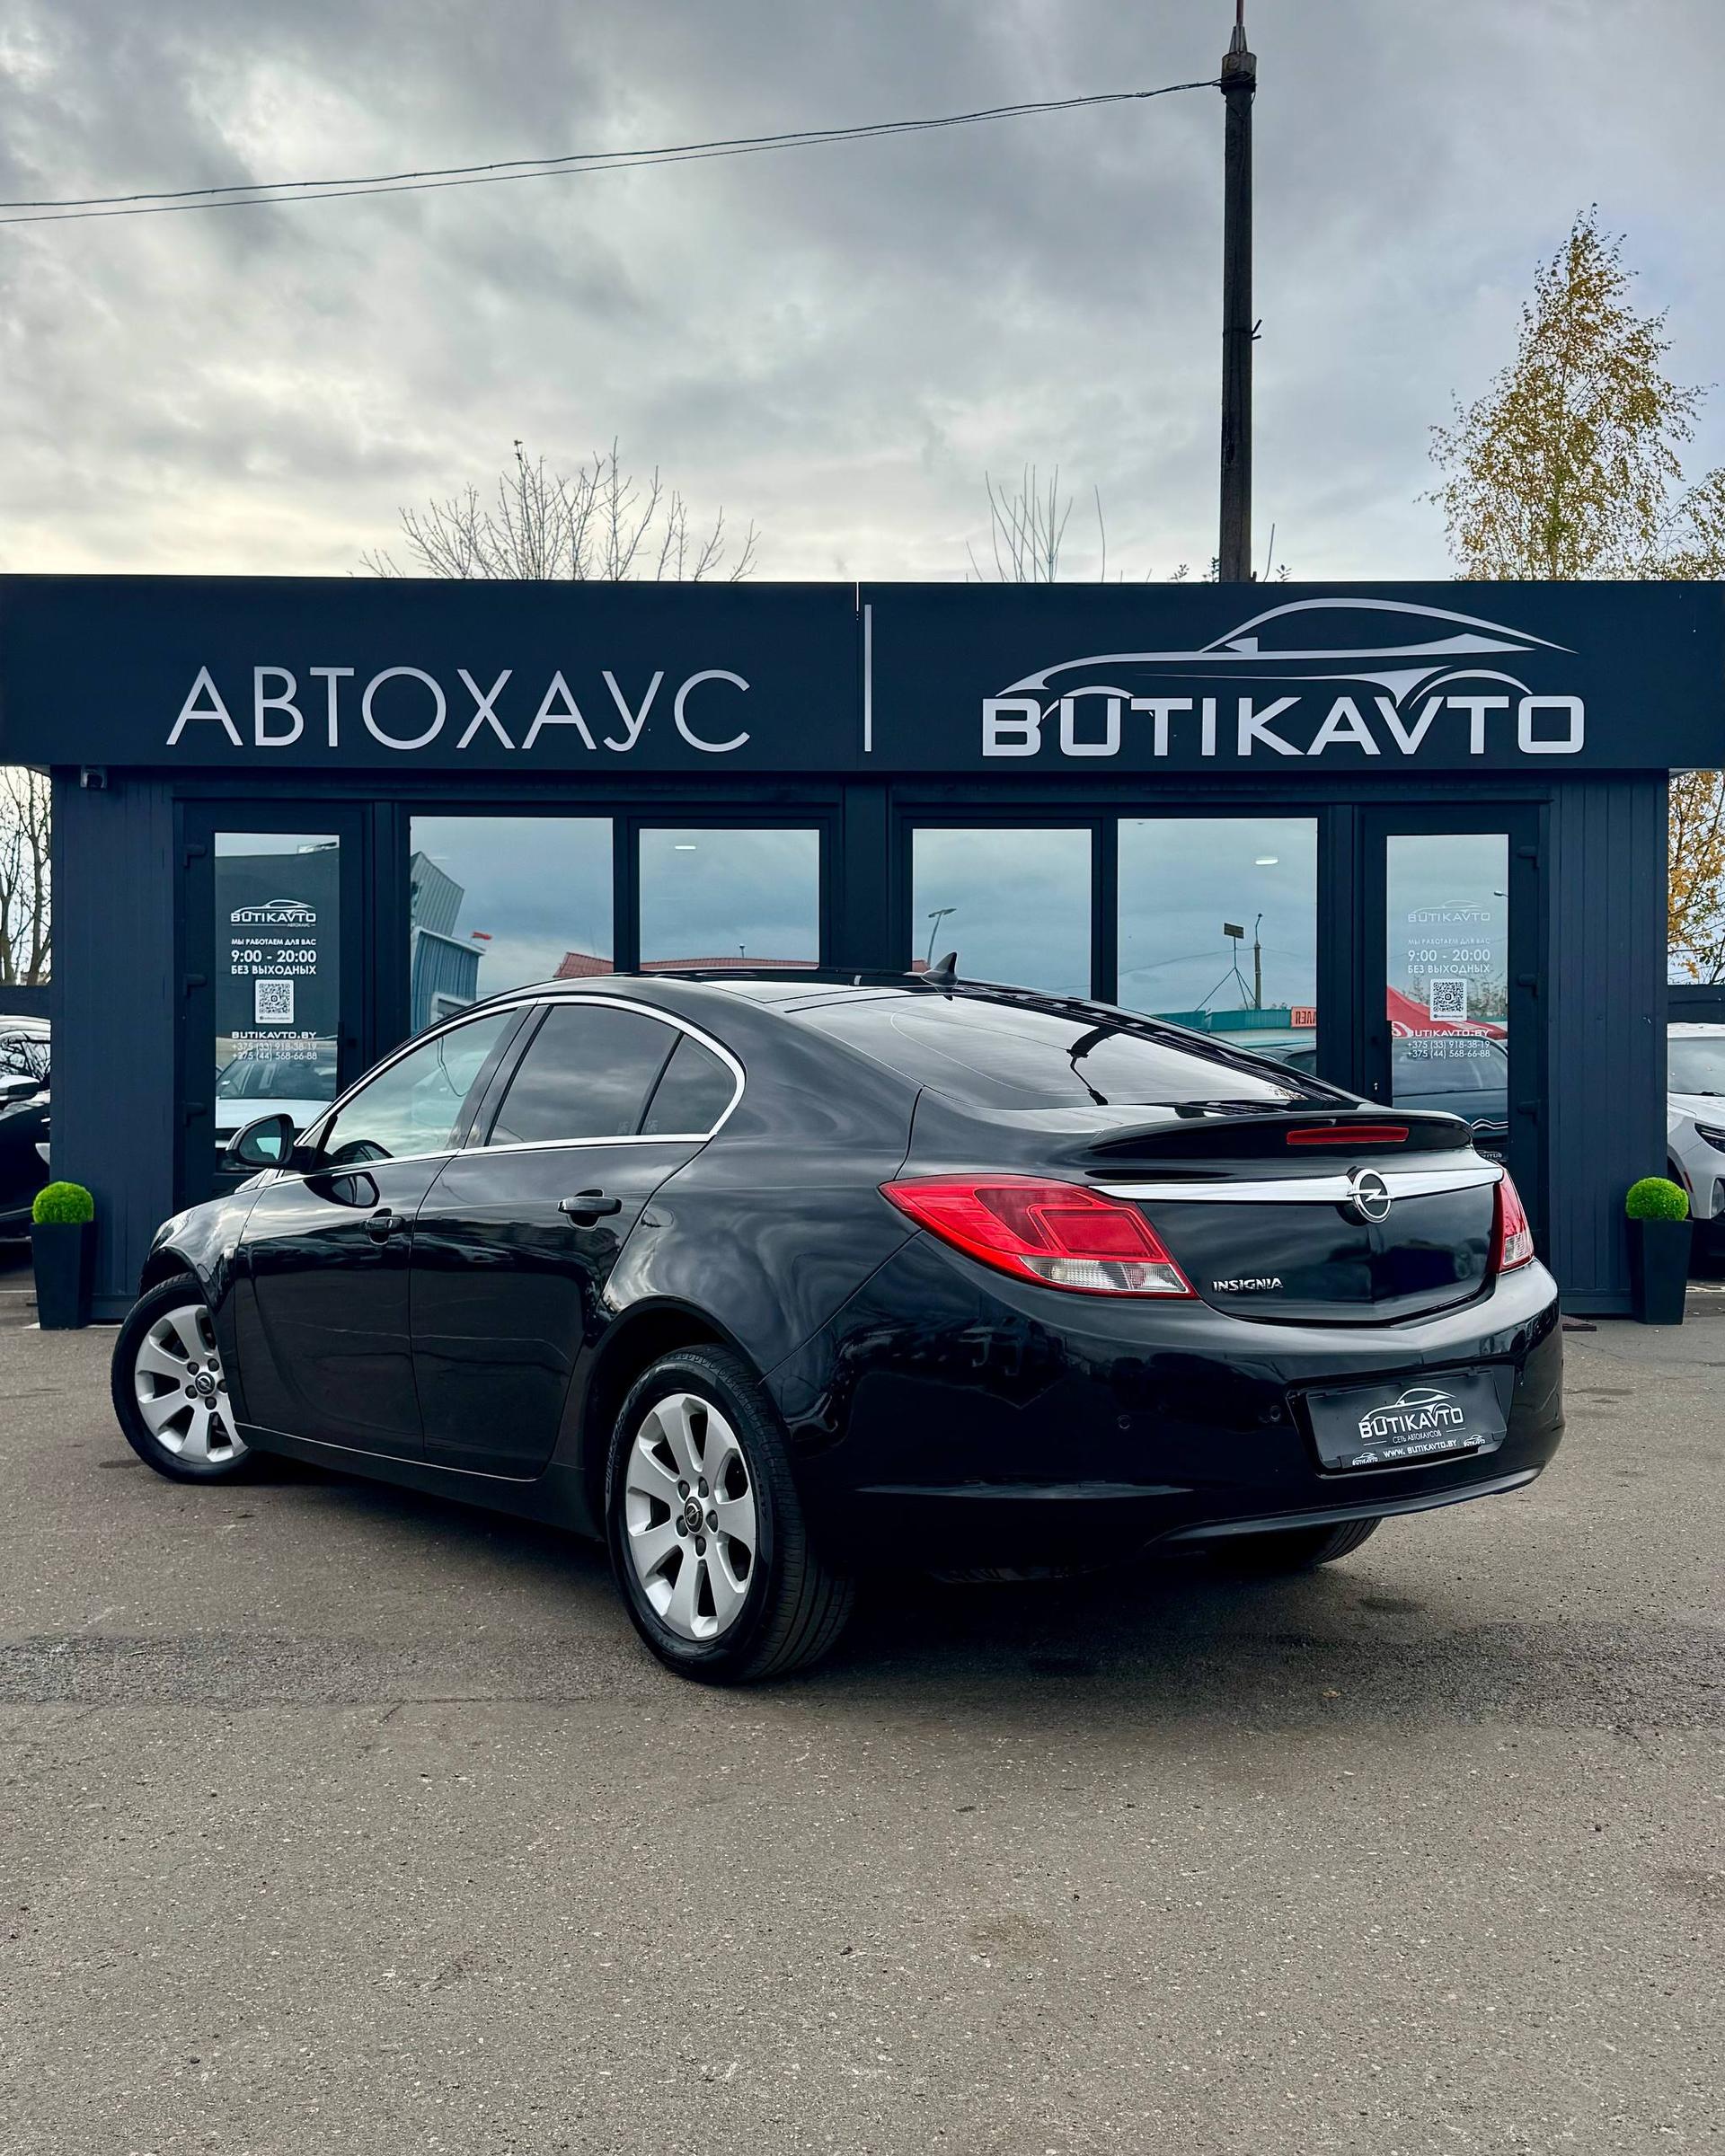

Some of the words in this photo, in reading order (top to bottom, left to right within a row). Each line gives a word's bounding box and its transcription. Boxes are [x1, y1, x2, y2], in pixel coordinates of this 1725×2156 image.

[166, 666, 751, 753] АВТОХАУС
[982, 694, 1585, 756] BUTIKAVTO
[231, 912, 316, 923] BUTIKAVTO
[1408, 912, 1491, 923] BUTIKAVTO
[231, 950, 262, 963] 9:00
[277, 950, 317, 963] 20:00
[1408, 950, 1438, 962] 9:00
[1452, 949, 1491, 961] 20:00
[231, 965, 249, 975] БЕЗ
[252, 965, 316, 976] ВЫХОДНЫХ
[1408, 965, 1424, 974] БЕЗ
[1428, 964, 1490, 974] ВЫХОДНЫХ
[232, 1031, 316, 1039] BUTIKAVTO.BY
[233, 1042, 253, 1051] +375
[256, 1042, 272, 1052] (33)
[275, 1042, 316, 1051] 918-38-19
[1408, 1040, 1428, 1049] +375
[1430, 1040, 1446, 1050] (33)
[1448, 1040, 1491, 1049] 918-38-19
[256, 1051, 272, 1061] (44)
[275, 1051, 317, 1060] 568-66-88
[1408, 1049, 1428, 1057] +375
[1430, 1049, 1446, 1059] (44)
[1448, 1049, 1491, 1057] 568-66-88
[1213, 1277, 1284, 1292] INSIGNIA
[1358, 1407, 1464, 1439] BUTIKAVTO
[1393, 1435, 1407, 1444] СЕТЬ
[1383, 1447, 1406, 1458] WWW.
[1407, 1439, 1457, 1454] BUTIKAVTO.BY
